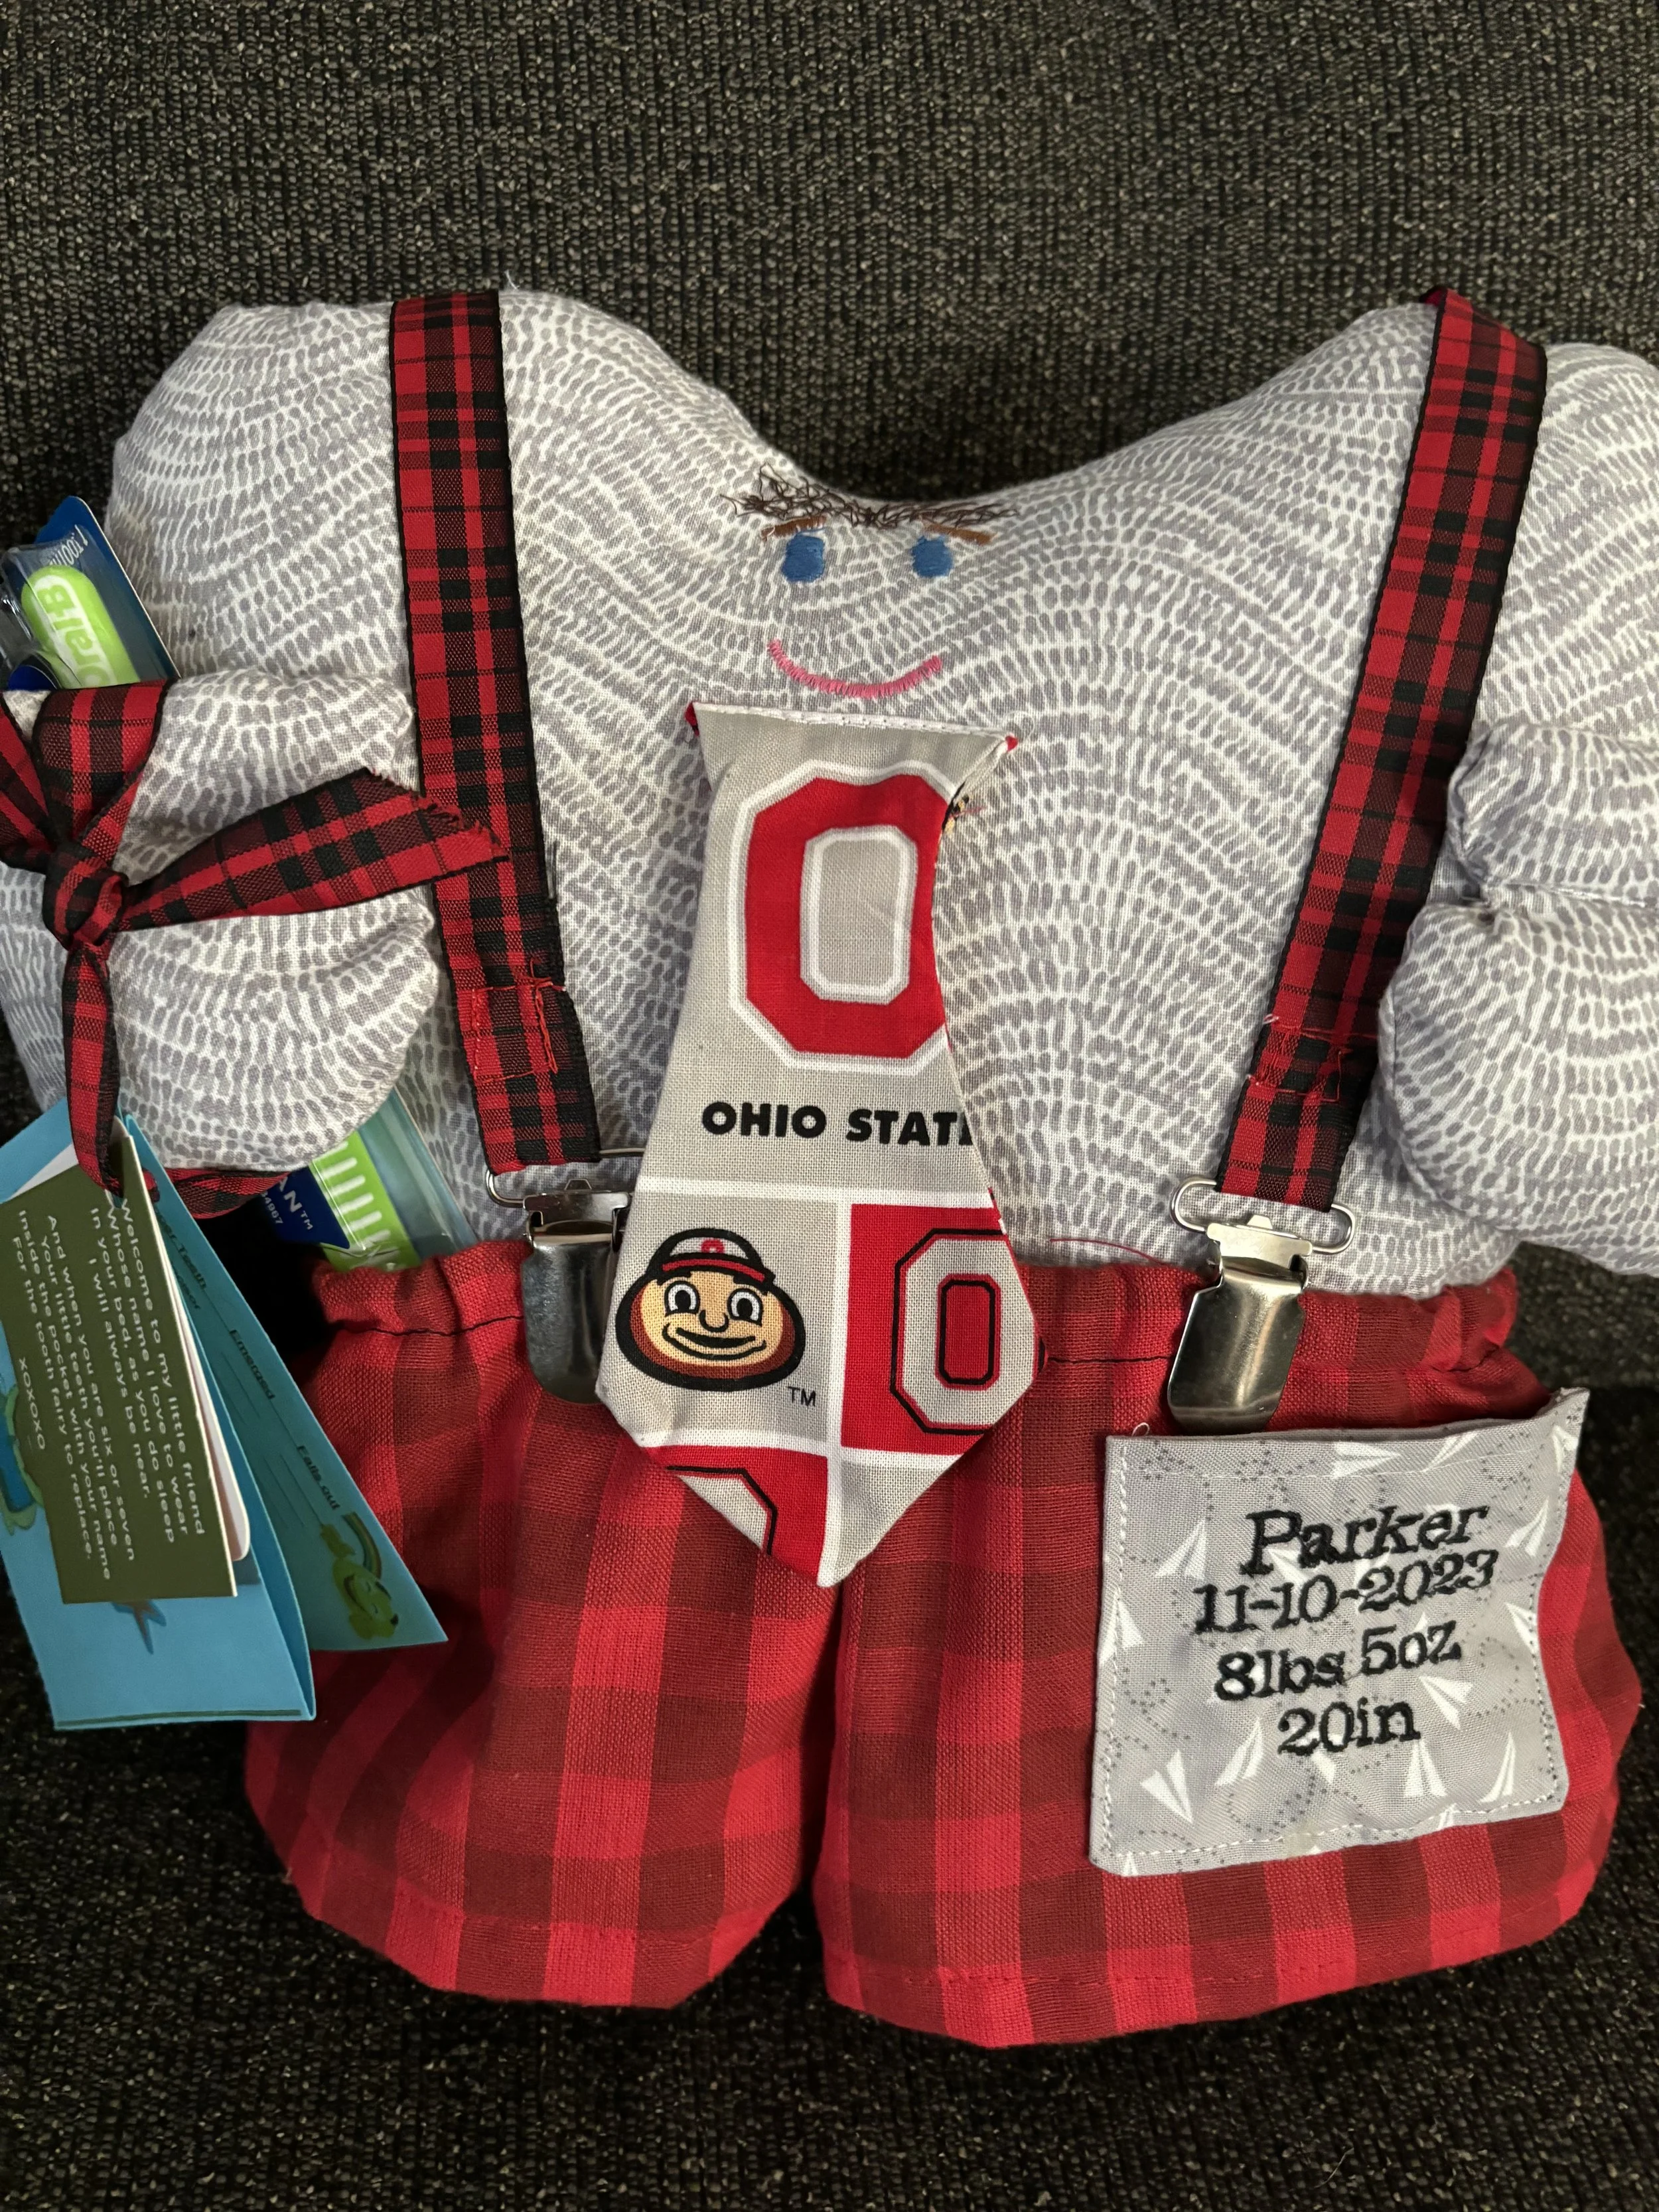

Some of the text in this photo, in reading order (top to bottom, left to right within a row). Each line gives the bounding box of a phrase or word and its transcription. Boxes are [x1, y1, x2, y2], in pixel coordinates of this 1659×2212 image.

[701, 1102, 827, 1138] OHIO
[13, 1236, 27, 1271] For
[25, 1279, 37, 1313] the
[35, 1321, 54, 1380] tooth
[51, 1387, 67, 1434] fairy
[64, 1443, 73, 1465] to
[19, 1210, 110, 1579] Inside the pocket with your name
[41, 1236, 58, 1284] Your
[55, 1293, 72, 1343] little
[70, 1351, 88, 1409] teeth
[99, 1485, 117, 1545] place
[48, 1215, 134, 1560] And when you are six or seven
[90, 1208, 101, 1229] In
[98, 1237, 117, 1288] your
[129, 1357, 139, 1381] as
[135, 1390, 151, 1432] you
[148, 1440, 159, 1471] do
[156, 1480, 175, 1543] sleep
[93, 1273, 109, 1312] will
[105, 1321, 128, 1398] always
[125, 1406, 136, 1434] be
[107, 1205, 131, 1288] Whose
[129, 1297, 149, 1361] name
[150, 1385, 166, 1434] love
[163, 1443, 173, 1467] to
[171, 1476, 188, 1534] wear
[121, 1198, 205, 1534] Welcome to my little friend
[1193, 1548, 1499, 1635] 11-10-2023
[1240, 1505, 1489, 1577] Parker
[1214, 1649, 1346, 1702] 8lbs
[1277, 1696, 1421, 1756] 20in
